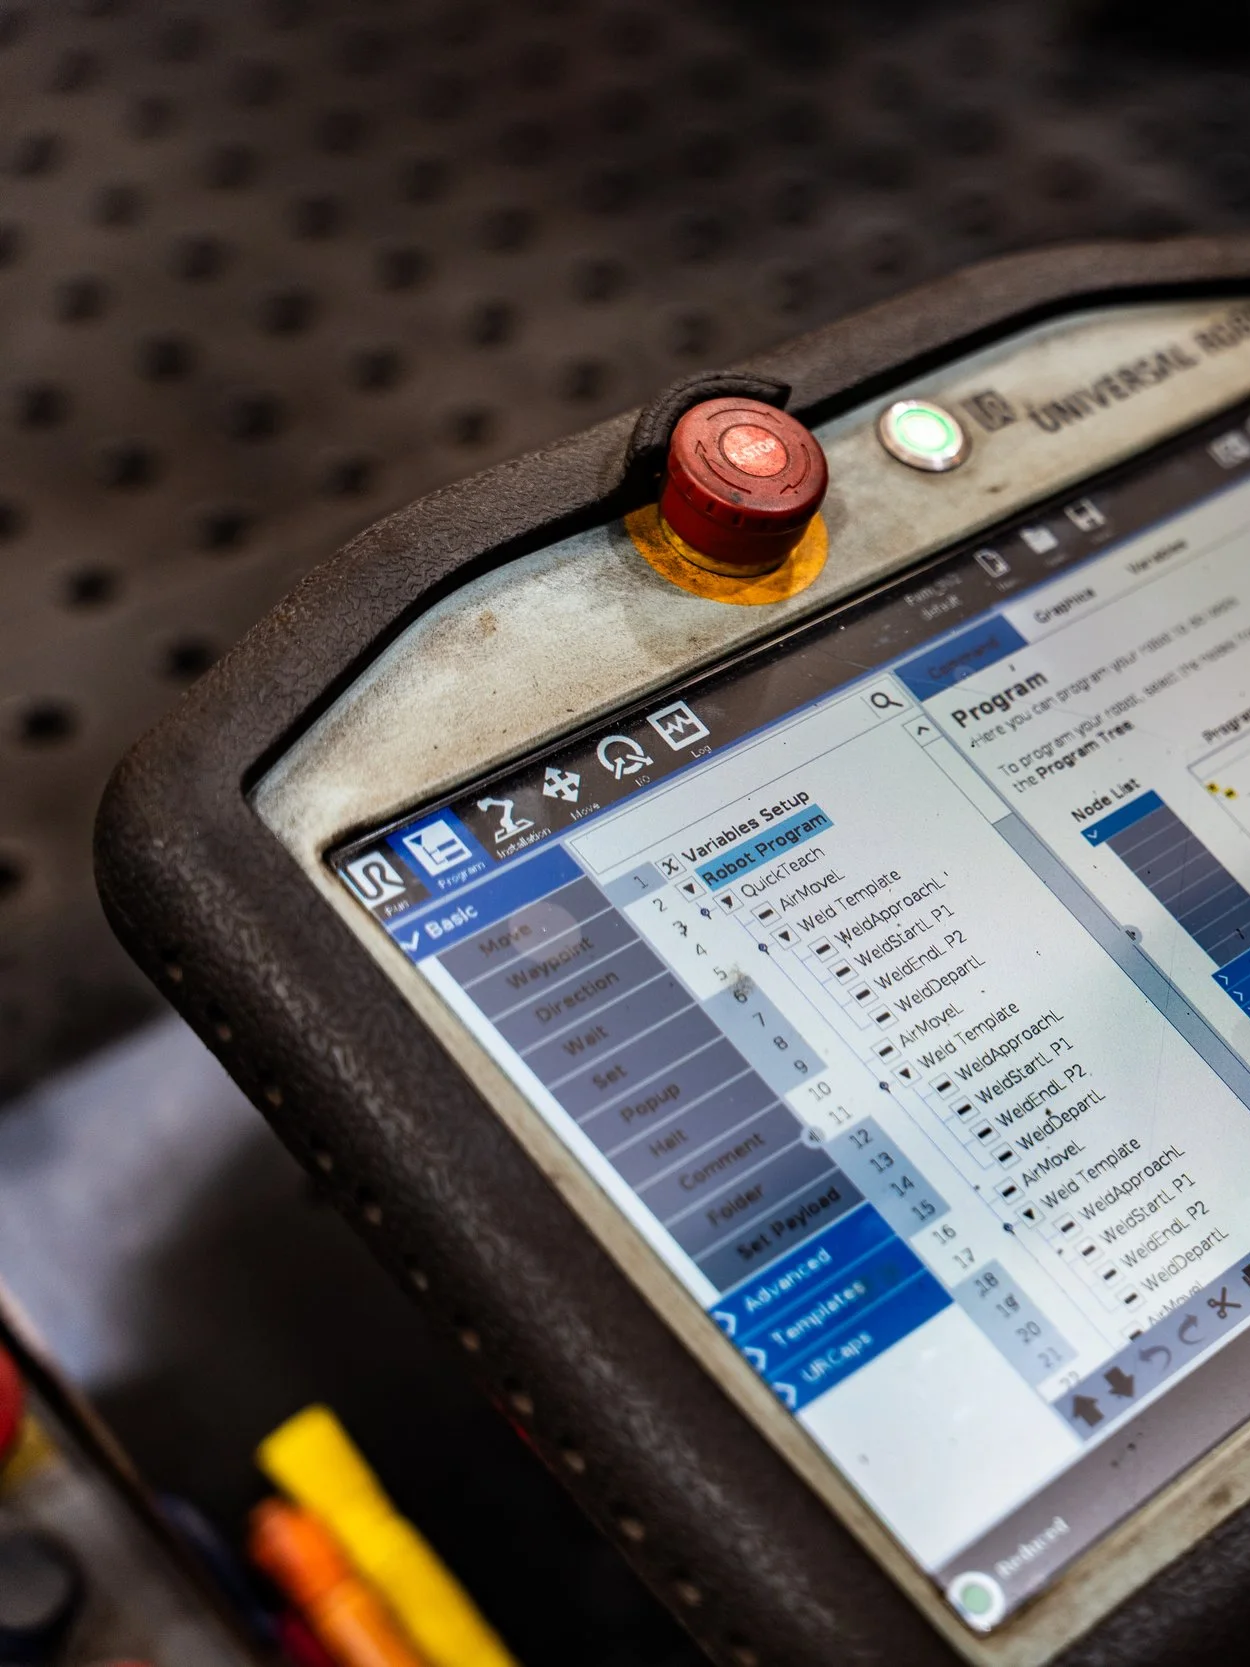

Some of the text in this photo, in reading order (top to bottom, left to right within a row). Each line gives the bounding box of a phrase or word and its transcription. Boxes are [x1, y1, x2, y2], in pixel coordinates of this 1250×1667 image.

[1024, 343, 1197, 433] UNIVERSAL
[952, 672, 1048, 728] Program
[976, 724, 1007, 747] Here
[1006, 707, 1032, 731] you
[1031, 698, 1057, 715] can
[1056, 666, 1108, 701] program
[1110, 652, 1138, 674] your
[691, 744, 712, 758] Log
[997, 762, 1020, 778] To
[1019, 730, 1074, 767] program
[1073, 714, 1104, 740] your
[1012, 719, 1135, 794] the Program Tree
[571, 802, 601, 820] Move
[1070, 777, 1141, 822] Node List
[496, 826, 552, 859] Installation
[682, 817, 760, 862] Variables
[760, 791, 810, 822] Setup
[702, 813, 827, 886] Robot Program
[741, 846, 826, 897] QuickTeach
[437, 861, 486, 889] Program
[634, 876, 649, 889] 1
[780, 869, 846, 911] AirMoveL
[424, 904, 478, 940] Basic
[653, 898, 668, 912] 2
[797, 869, 901, 933] Weld Template
[834, 877, 947, 945] WeldApproachL
[478, 923, 532, 958] Move
[673, 920, 688, 937] 3
[696, 943, 707, 956] 4
[854, 905, 955, 967] WeldStartL P1
[506, 937, 595, 989] Waypoint
[713, 966, 728, 981] 5
[874, 930, 968, 990] WeldEndL P2
[535, 970, 620, 1023] Direction
[733, 988, 748, 1003] 6
[894, 954, 986, 1013] WeldDepartL
[563, 1025, 610, 1057] Wait
[752, 1012, 765, 1027] 7
[899, 1003, 965, 1048] AirMoveL
[917, 1001, 1020, 1069] Weld Template
[773, 1035, 788, 1050] 8
[955, 1009, 1064, 1081] WeldApproachL
[593, 1065, 628, 1090] Set
[793, 1059, 808, 1074] 9
[975, 1037, 1074, 1104] WeldStartL P1
[620, 1081, 681, 1123] Popup
[808, 1081, 832, 1102] 10
[996, 1063, 1088, 1127] WeldEndL P2
[829, 1106, 853, 1125] 11
[1016, 1089, 1106, 1151] WeldDepartL
[649, 1128, 689, 1157] Halt
[849, 1128, 873, 1149] 12
[679, 1132, 766, 1191] Comment
[870, 1152, 894, 1173] 13
[1022, 1139, 1086, 1188] AirMoveL
[1040, 1137, 1141, 1209] Weld Template
[1078, 1144, 1186, 1221] WeldApproachL
[706, 1184, 764, 1228] Folder
[890, 1175, 915, 1197] 14
[1099, 1173, 1197, 1244] WeldStartL P1
[736, 1186, 842, 1262] Set Payload
[911, 1199, 936, 1221] 15
[932, 1224, 957, 1246] 16
[1120, 1199, 1211, 1268] WeldEndL P2
[744, 1247, 833, 1314] Advanced
[953, 1247, 975, 1269] 17
[1140, 1226, 1230, 1292] WeldDepartL
[975, 1272, 999, 1297] 18
[996, 1293, 1020, 1318] 19
[769, 1280, 867, 1347] Templates
[1015, 1321, 1042, 1344] 20
[802, 1331, 874, 1383] URCaps
[995, 1516, 1069, 1579] Reduced
